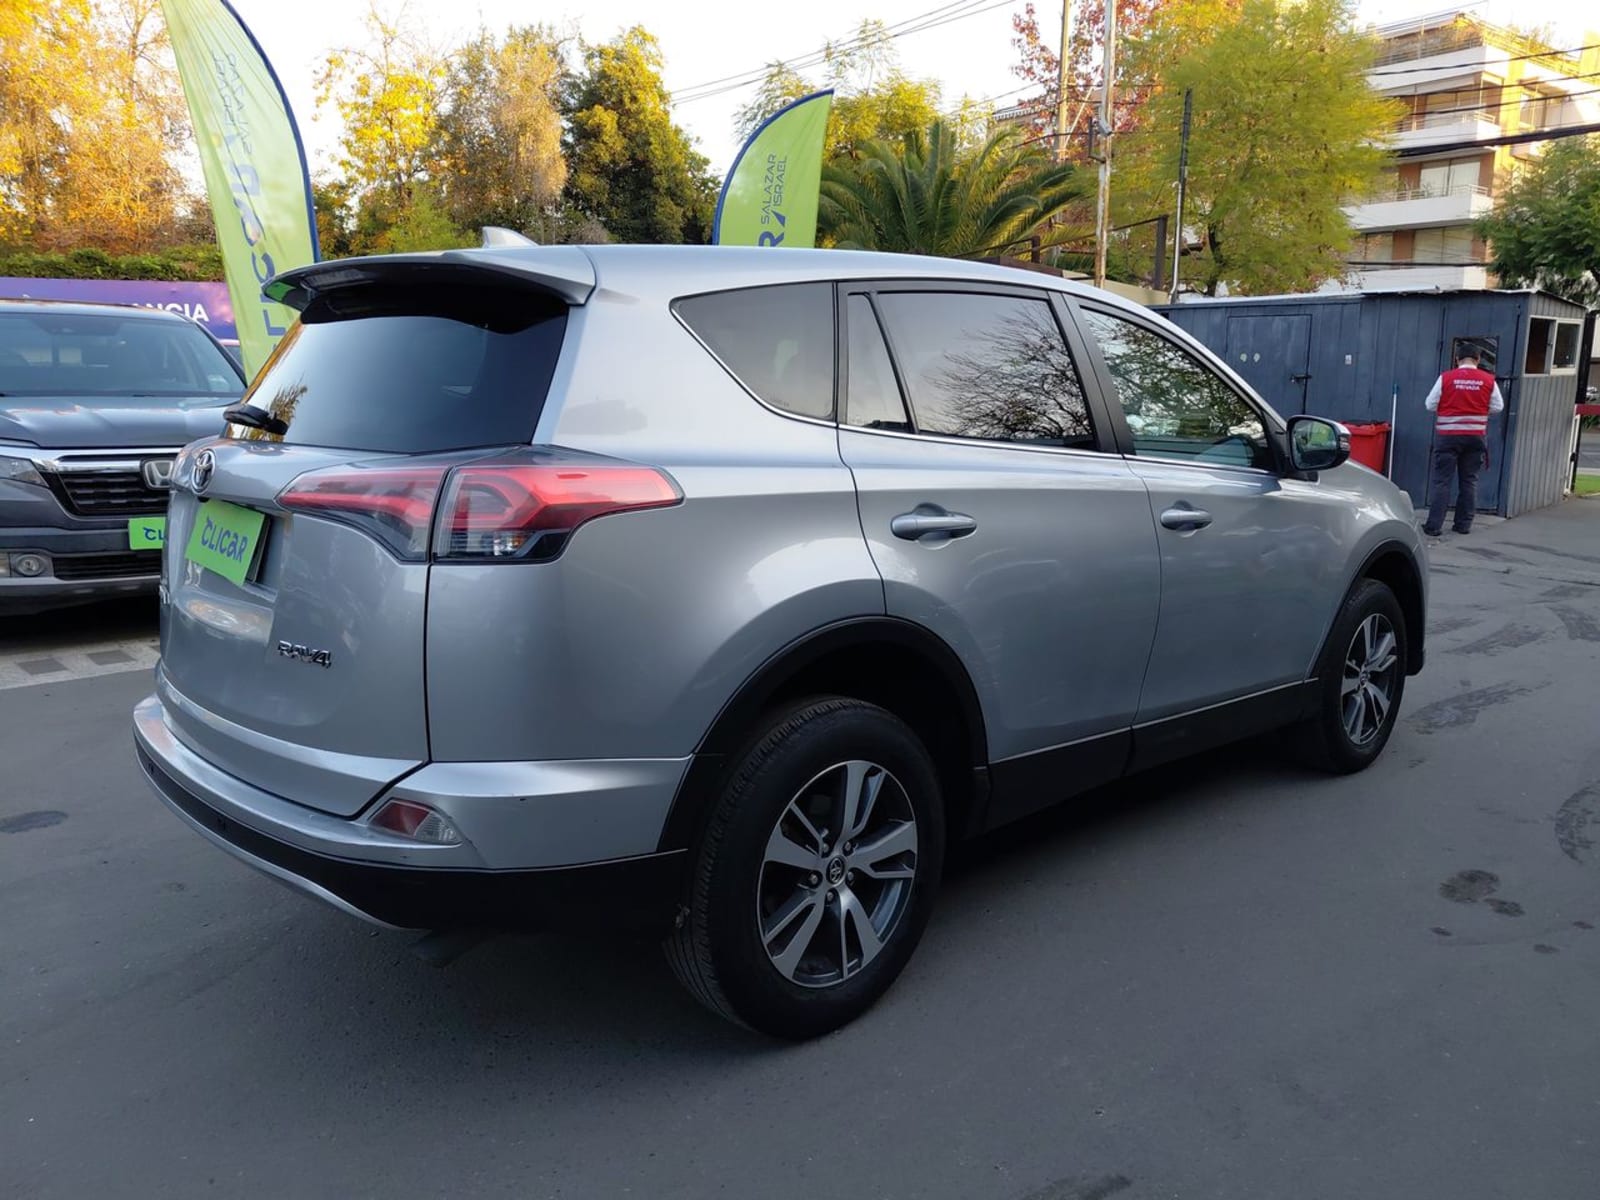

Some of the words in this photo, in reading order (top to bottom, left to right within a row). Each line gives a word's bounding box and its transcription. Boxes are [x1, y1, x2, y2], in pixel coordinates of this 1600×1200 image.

[761, 154, 776, 224] SALAZAR
[772, 156, 788, 206] ISRAEL
[278, 640, 332, 669] RAV4
